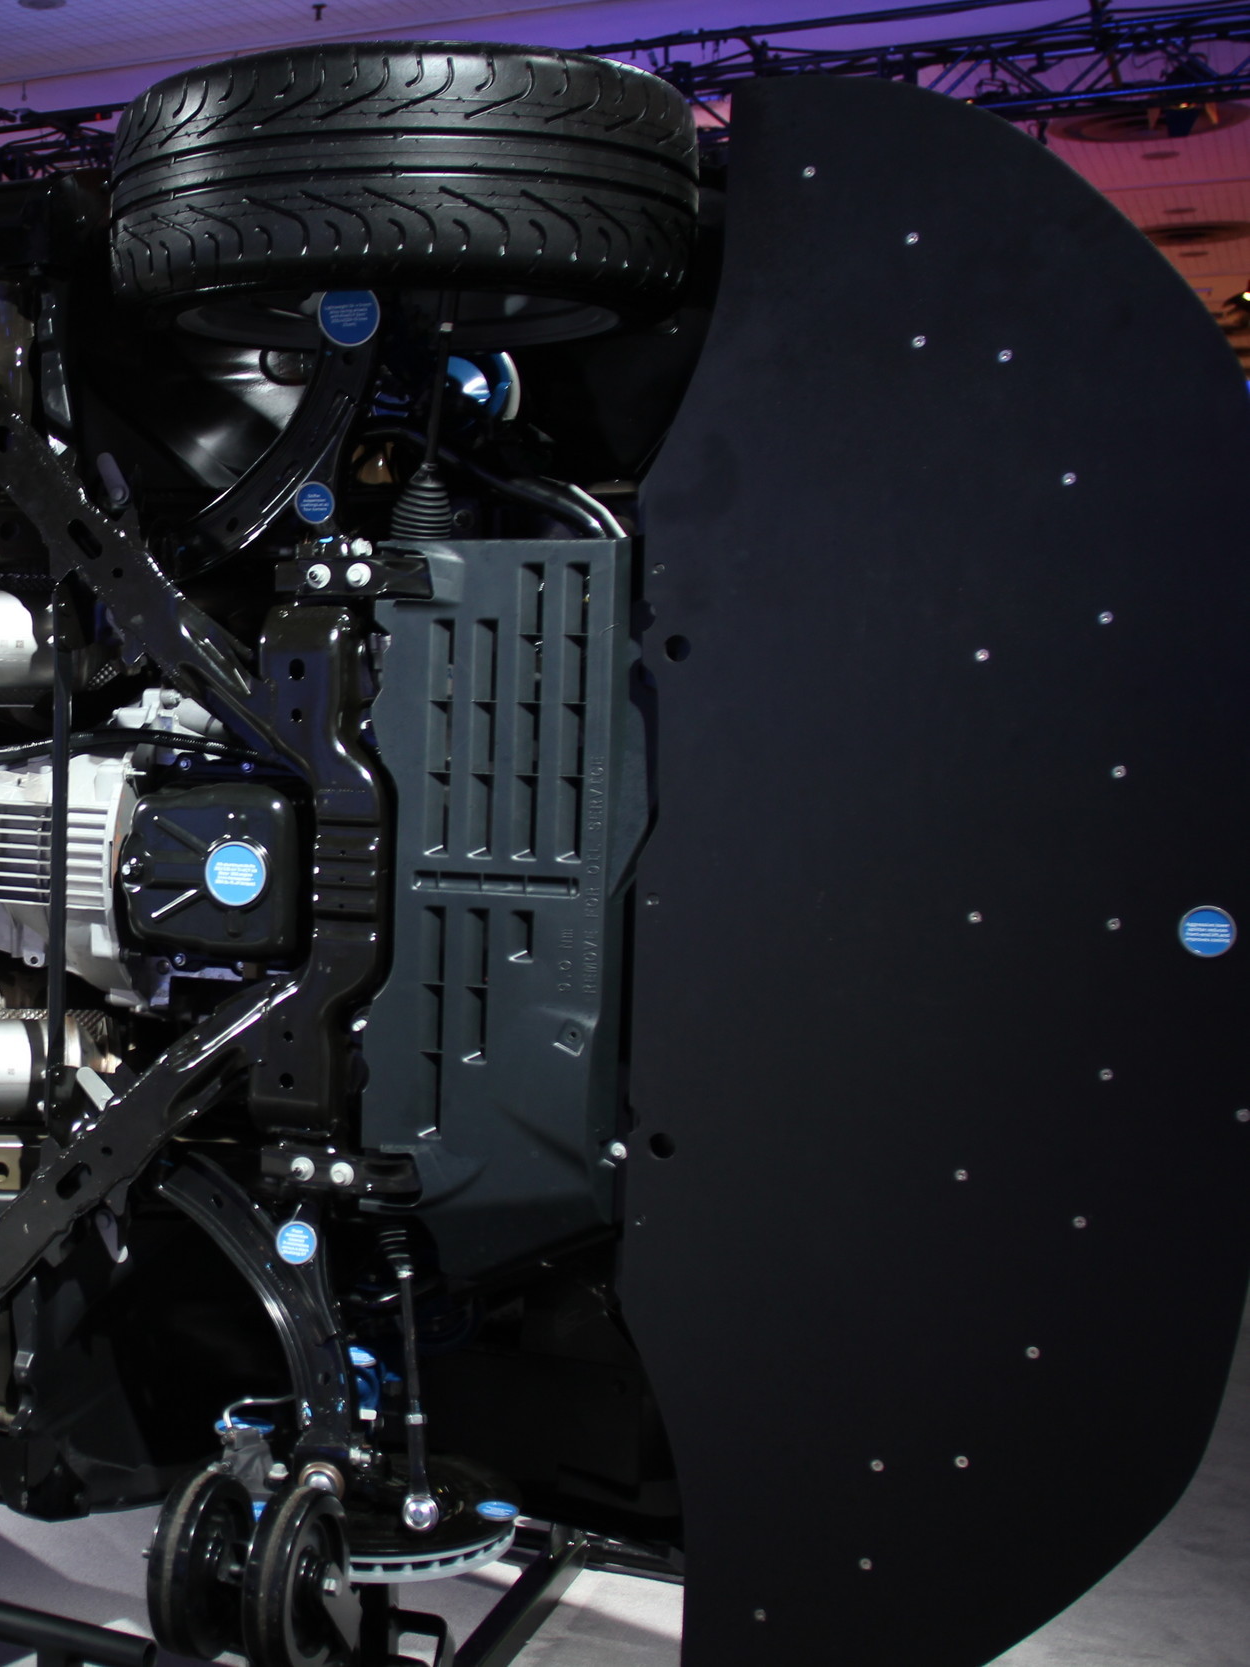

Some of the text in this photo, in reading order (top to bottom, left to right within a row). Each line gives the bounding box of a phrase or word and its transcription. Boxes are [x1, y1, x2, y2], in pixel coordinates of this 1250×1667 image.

[583, 756, 605, 994] REMOVE FOR OIL SERVICE
